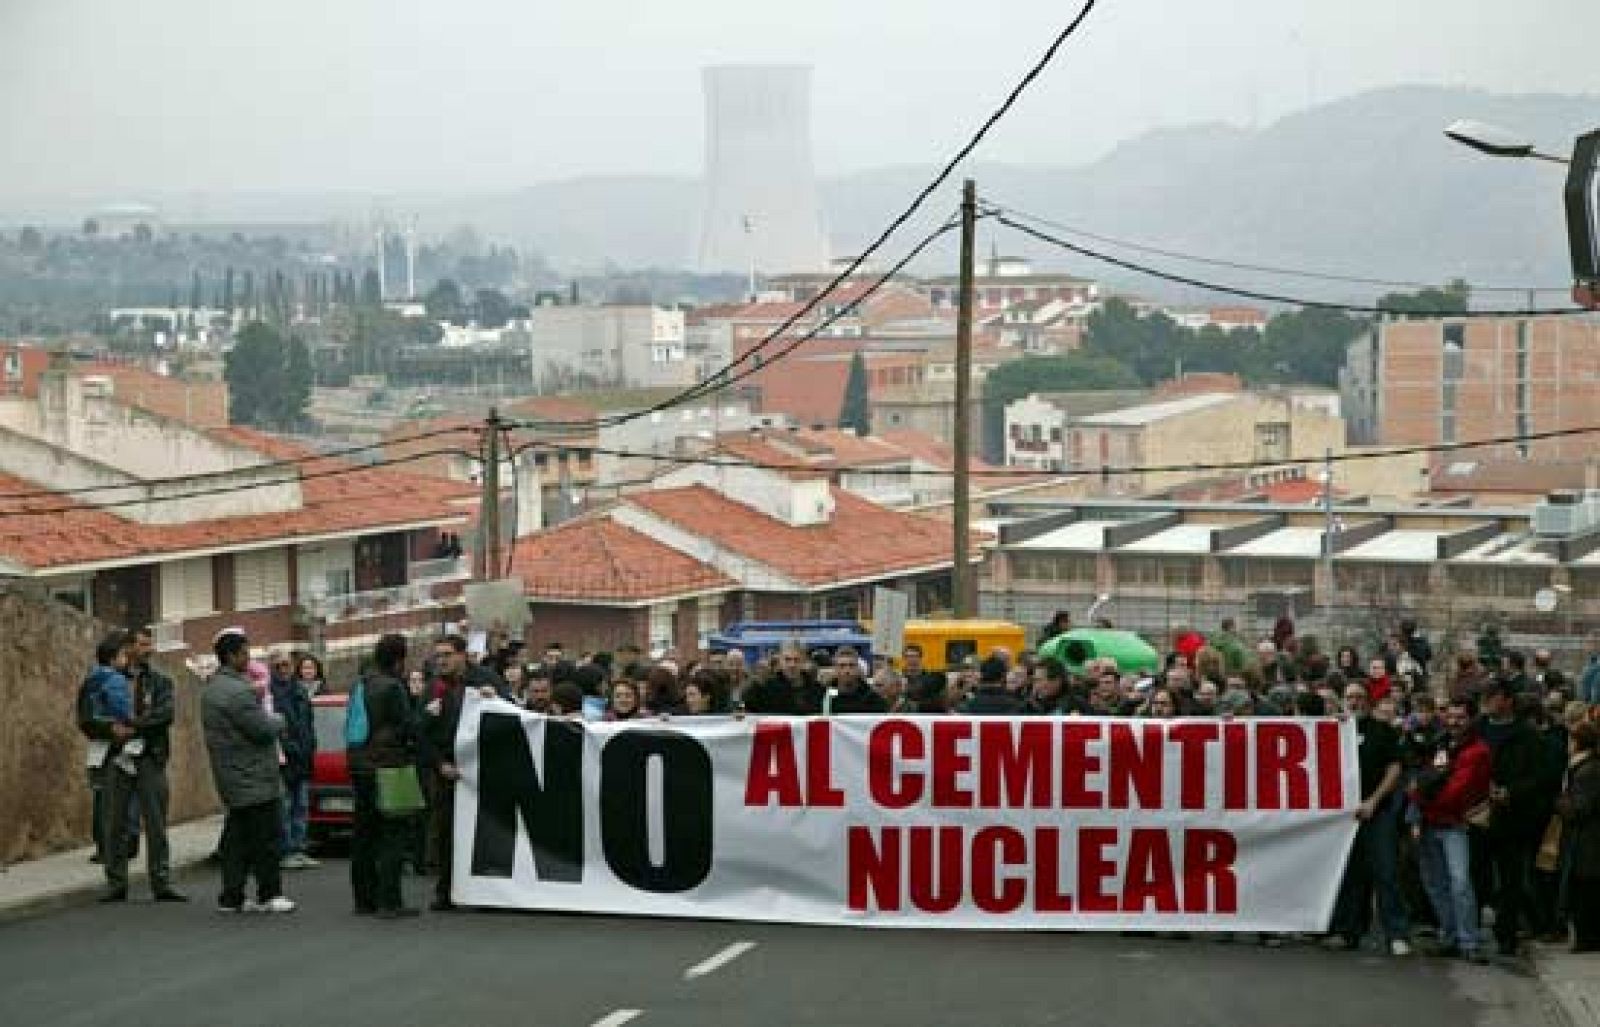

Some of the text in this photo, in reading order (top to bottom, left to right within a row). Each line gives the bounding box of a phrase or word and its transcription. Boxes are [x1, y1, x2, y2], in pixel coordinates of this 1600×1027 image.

[471, 711, 714, 894] NO
[744, 719, 1345, 810] AL CEMENTIRI
[847, 827, 1239, 914] NUCLEAR
